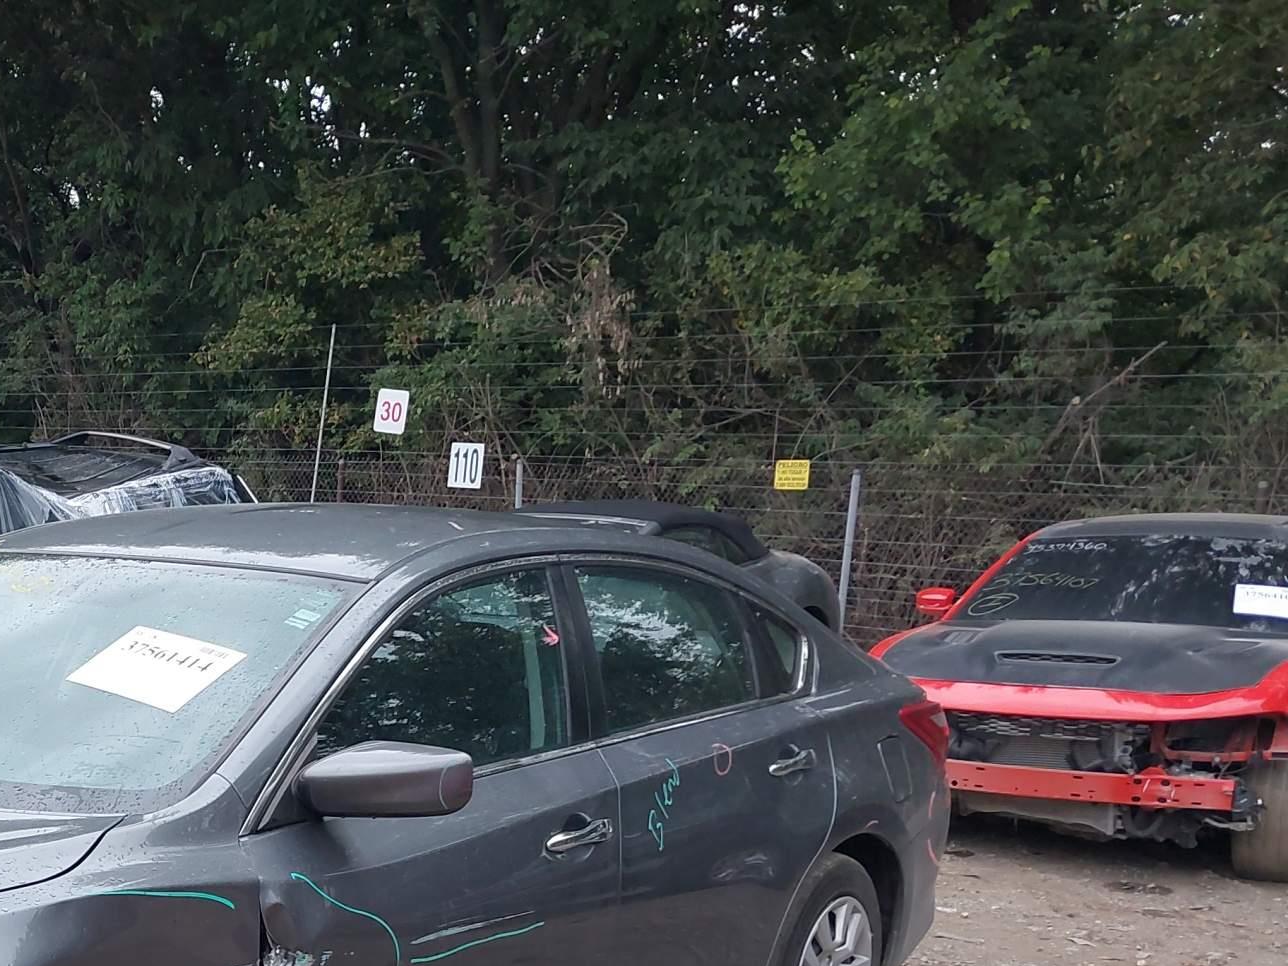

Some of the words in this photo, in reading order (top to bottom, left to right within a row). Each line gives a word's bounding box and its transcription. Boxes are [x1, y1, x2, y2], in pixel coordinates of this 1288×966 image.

[380, 401, 402, 422] 30
[454, 447, 479, 484] 110
[125, 641, 213, 671] 37561414
